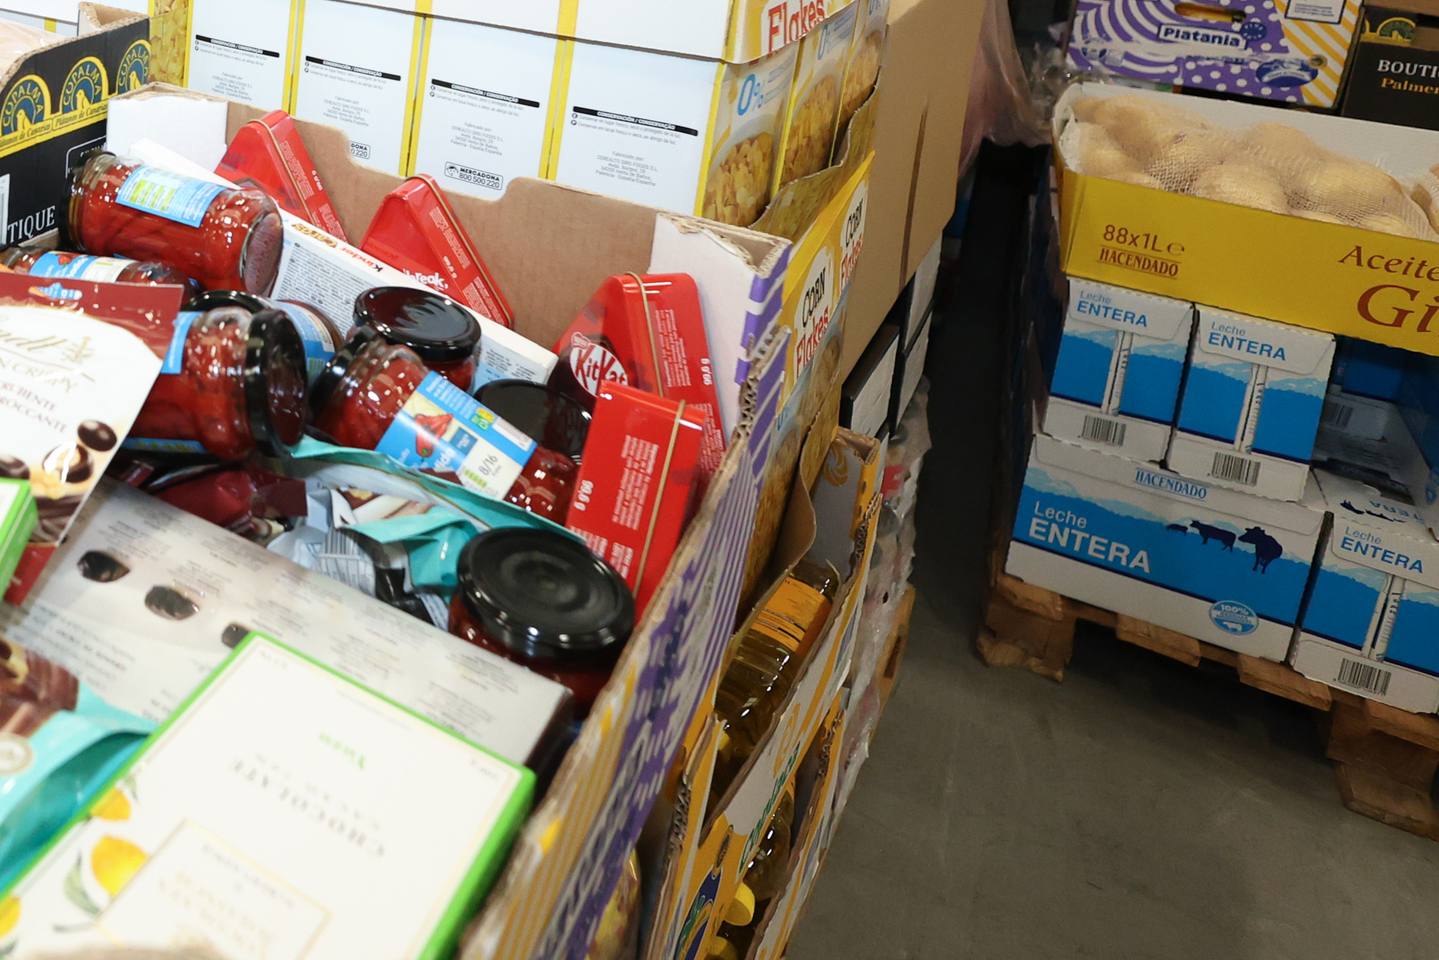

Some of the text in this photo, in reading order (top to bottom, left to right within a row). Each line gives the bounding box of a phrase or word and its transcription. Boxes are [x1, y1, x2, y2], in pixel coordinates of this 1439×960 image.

[1377, 58, 1439, 79] BOUTI
[63, 65, 102, 107] COPALMA
[2, 82, 44, 128] COPALMA
[472, 175, 486, 185] 500
[486, 179, 500, 189] 220
[7, 205, 56, 243] TIQUE
[845, 198, 864, 248] CORN
[1103, 224, 1162, 254] 88x1L
[341, 246, 383, 272] Kinder
[1099, 248, 1180, 277] HACENDADO
[802, 268, 826, 329] CORN
[1079, 289, 1112, 304] Leche
[1356, 284, 1439, 334] Gi
[1076, 300, 1148, 327] ENTERA
[1211, 321, 1246, 337] Leche
[796, 305, 830, 374] Flakes
[1208, 331, 1286, 361] ENTERA
[574, 342, 628, 394] KitKat
[1136, 468, 1207, 500] HACENDADO
[1034, 501, 1087, 529] Leche
[1028, 516, 1152, 574] ENTERA
[1345, 525, 1383, 545] Leche
[1340, 535, 1423, 574] ENTERA
